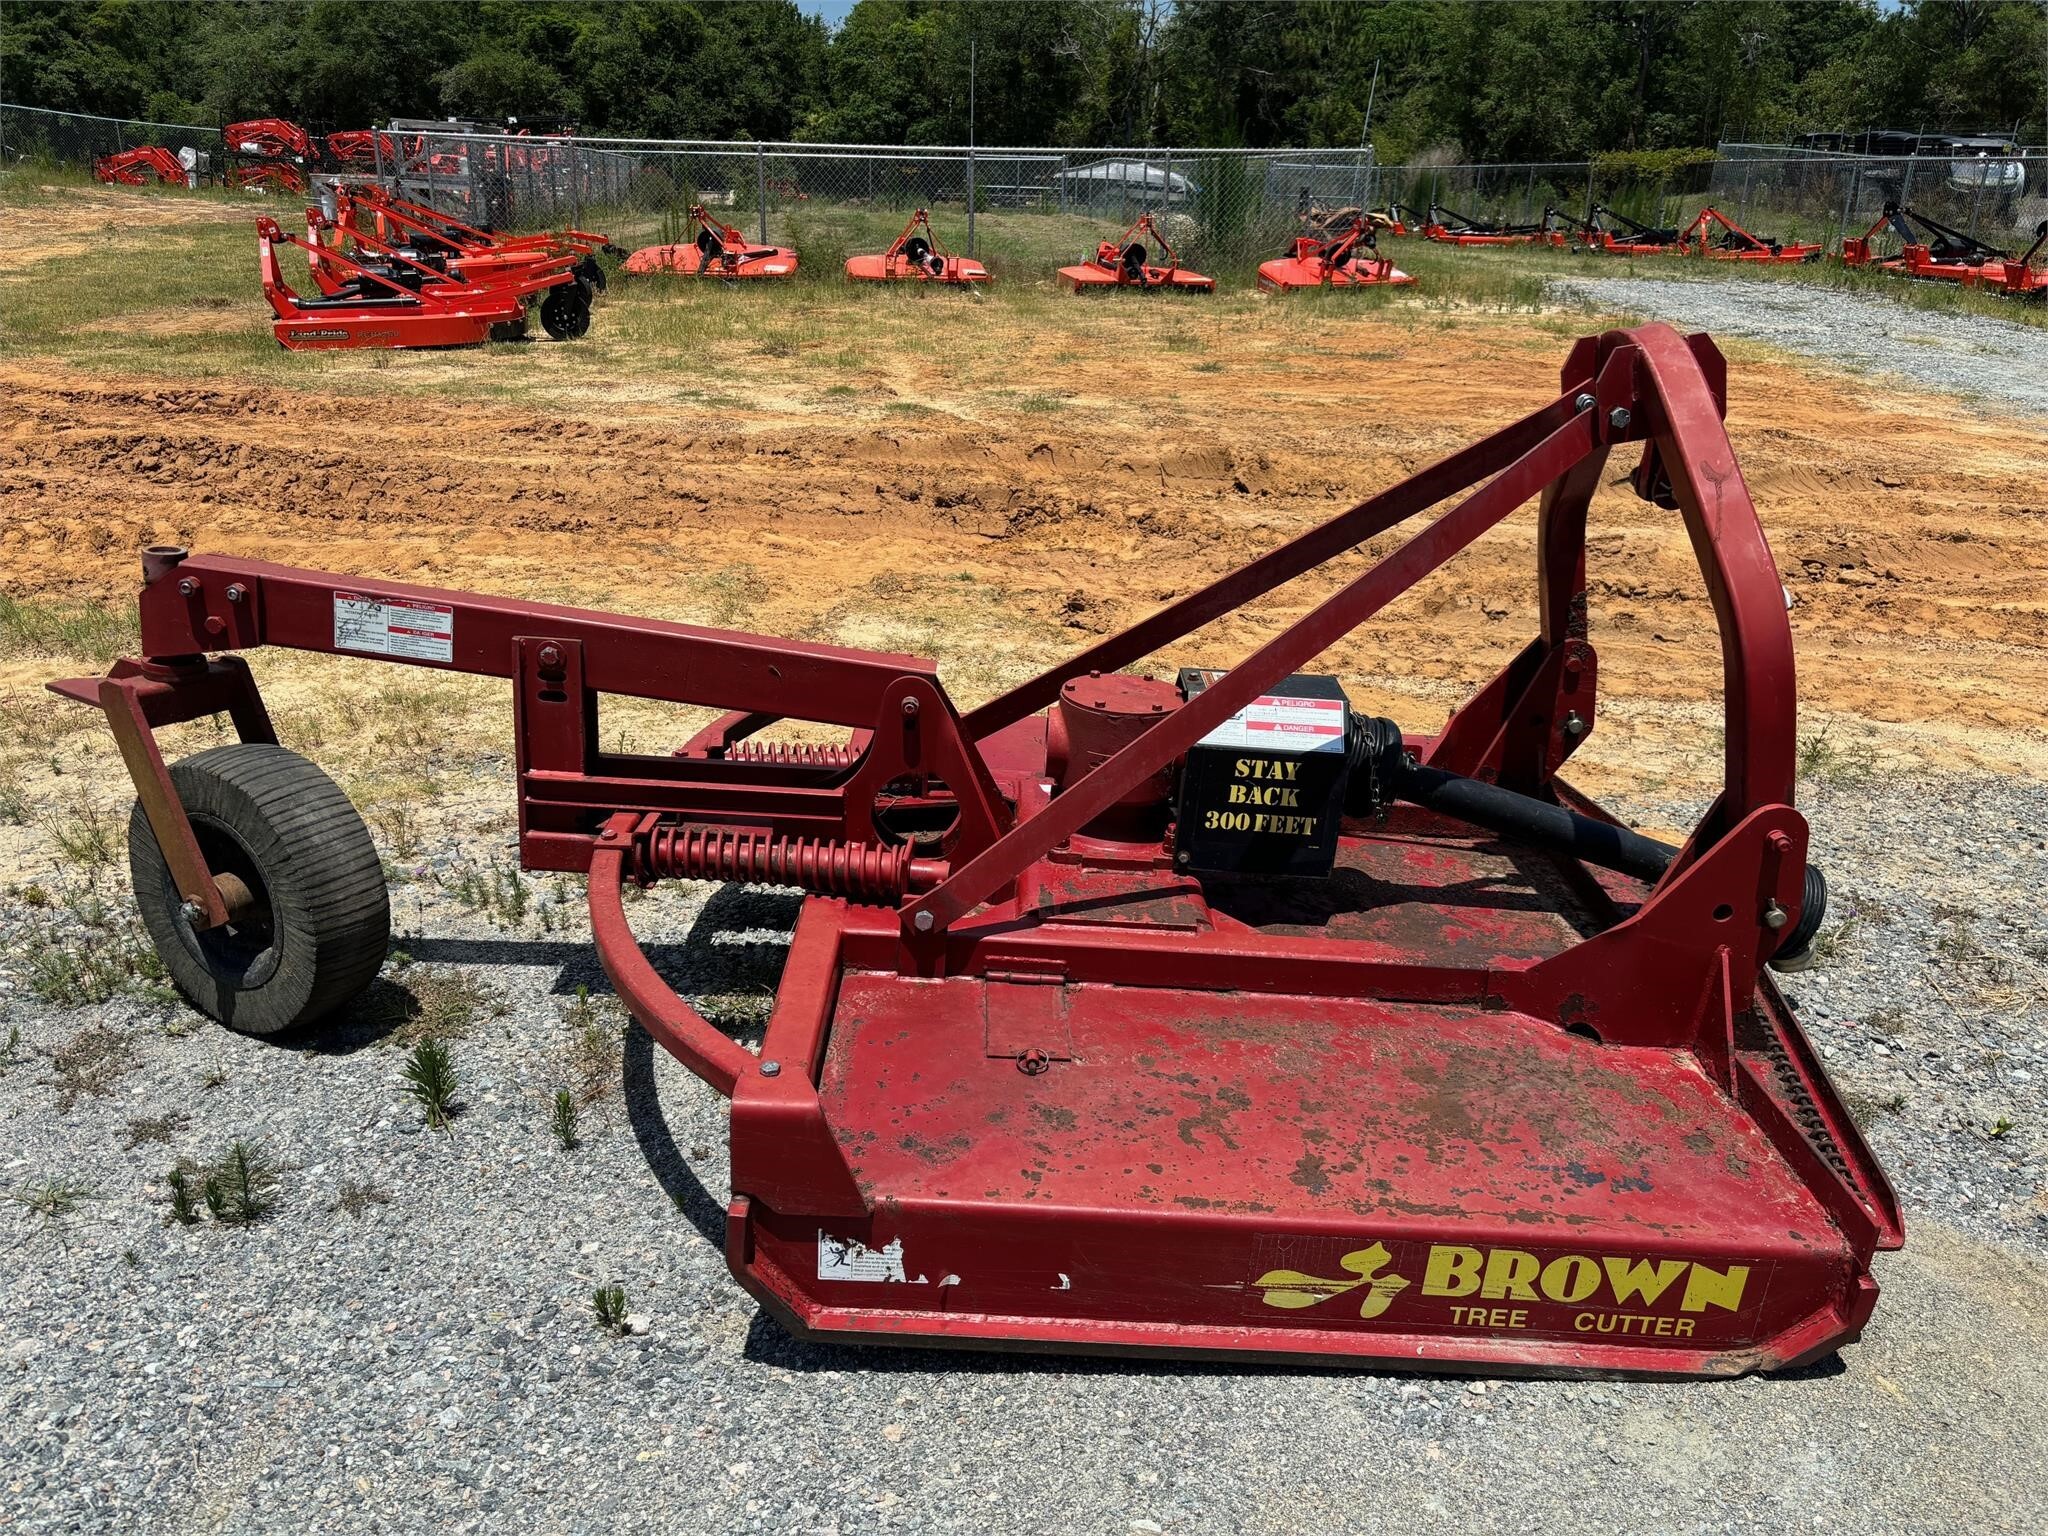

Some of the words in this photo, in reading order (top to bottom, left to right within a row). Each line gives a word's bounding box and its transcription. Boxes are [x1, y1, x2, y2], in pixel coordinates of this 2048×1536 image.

[1281, 699, 1316, 708] PELIGRO
[1283, 724, 1315, 733] DANGER
[1235, 758, 1302, 781] STAY
[1228, 784, 1301, 807] BACK
[1204, 810, 1251, 831] 300
[1253, 813, 1318, 836] FEET
[1421, 1245, 1751, 1313] BROWN
[1449, 1306, 1528, 1329] TREE
[1573, 1312, 1697, 1338] CUTTER
